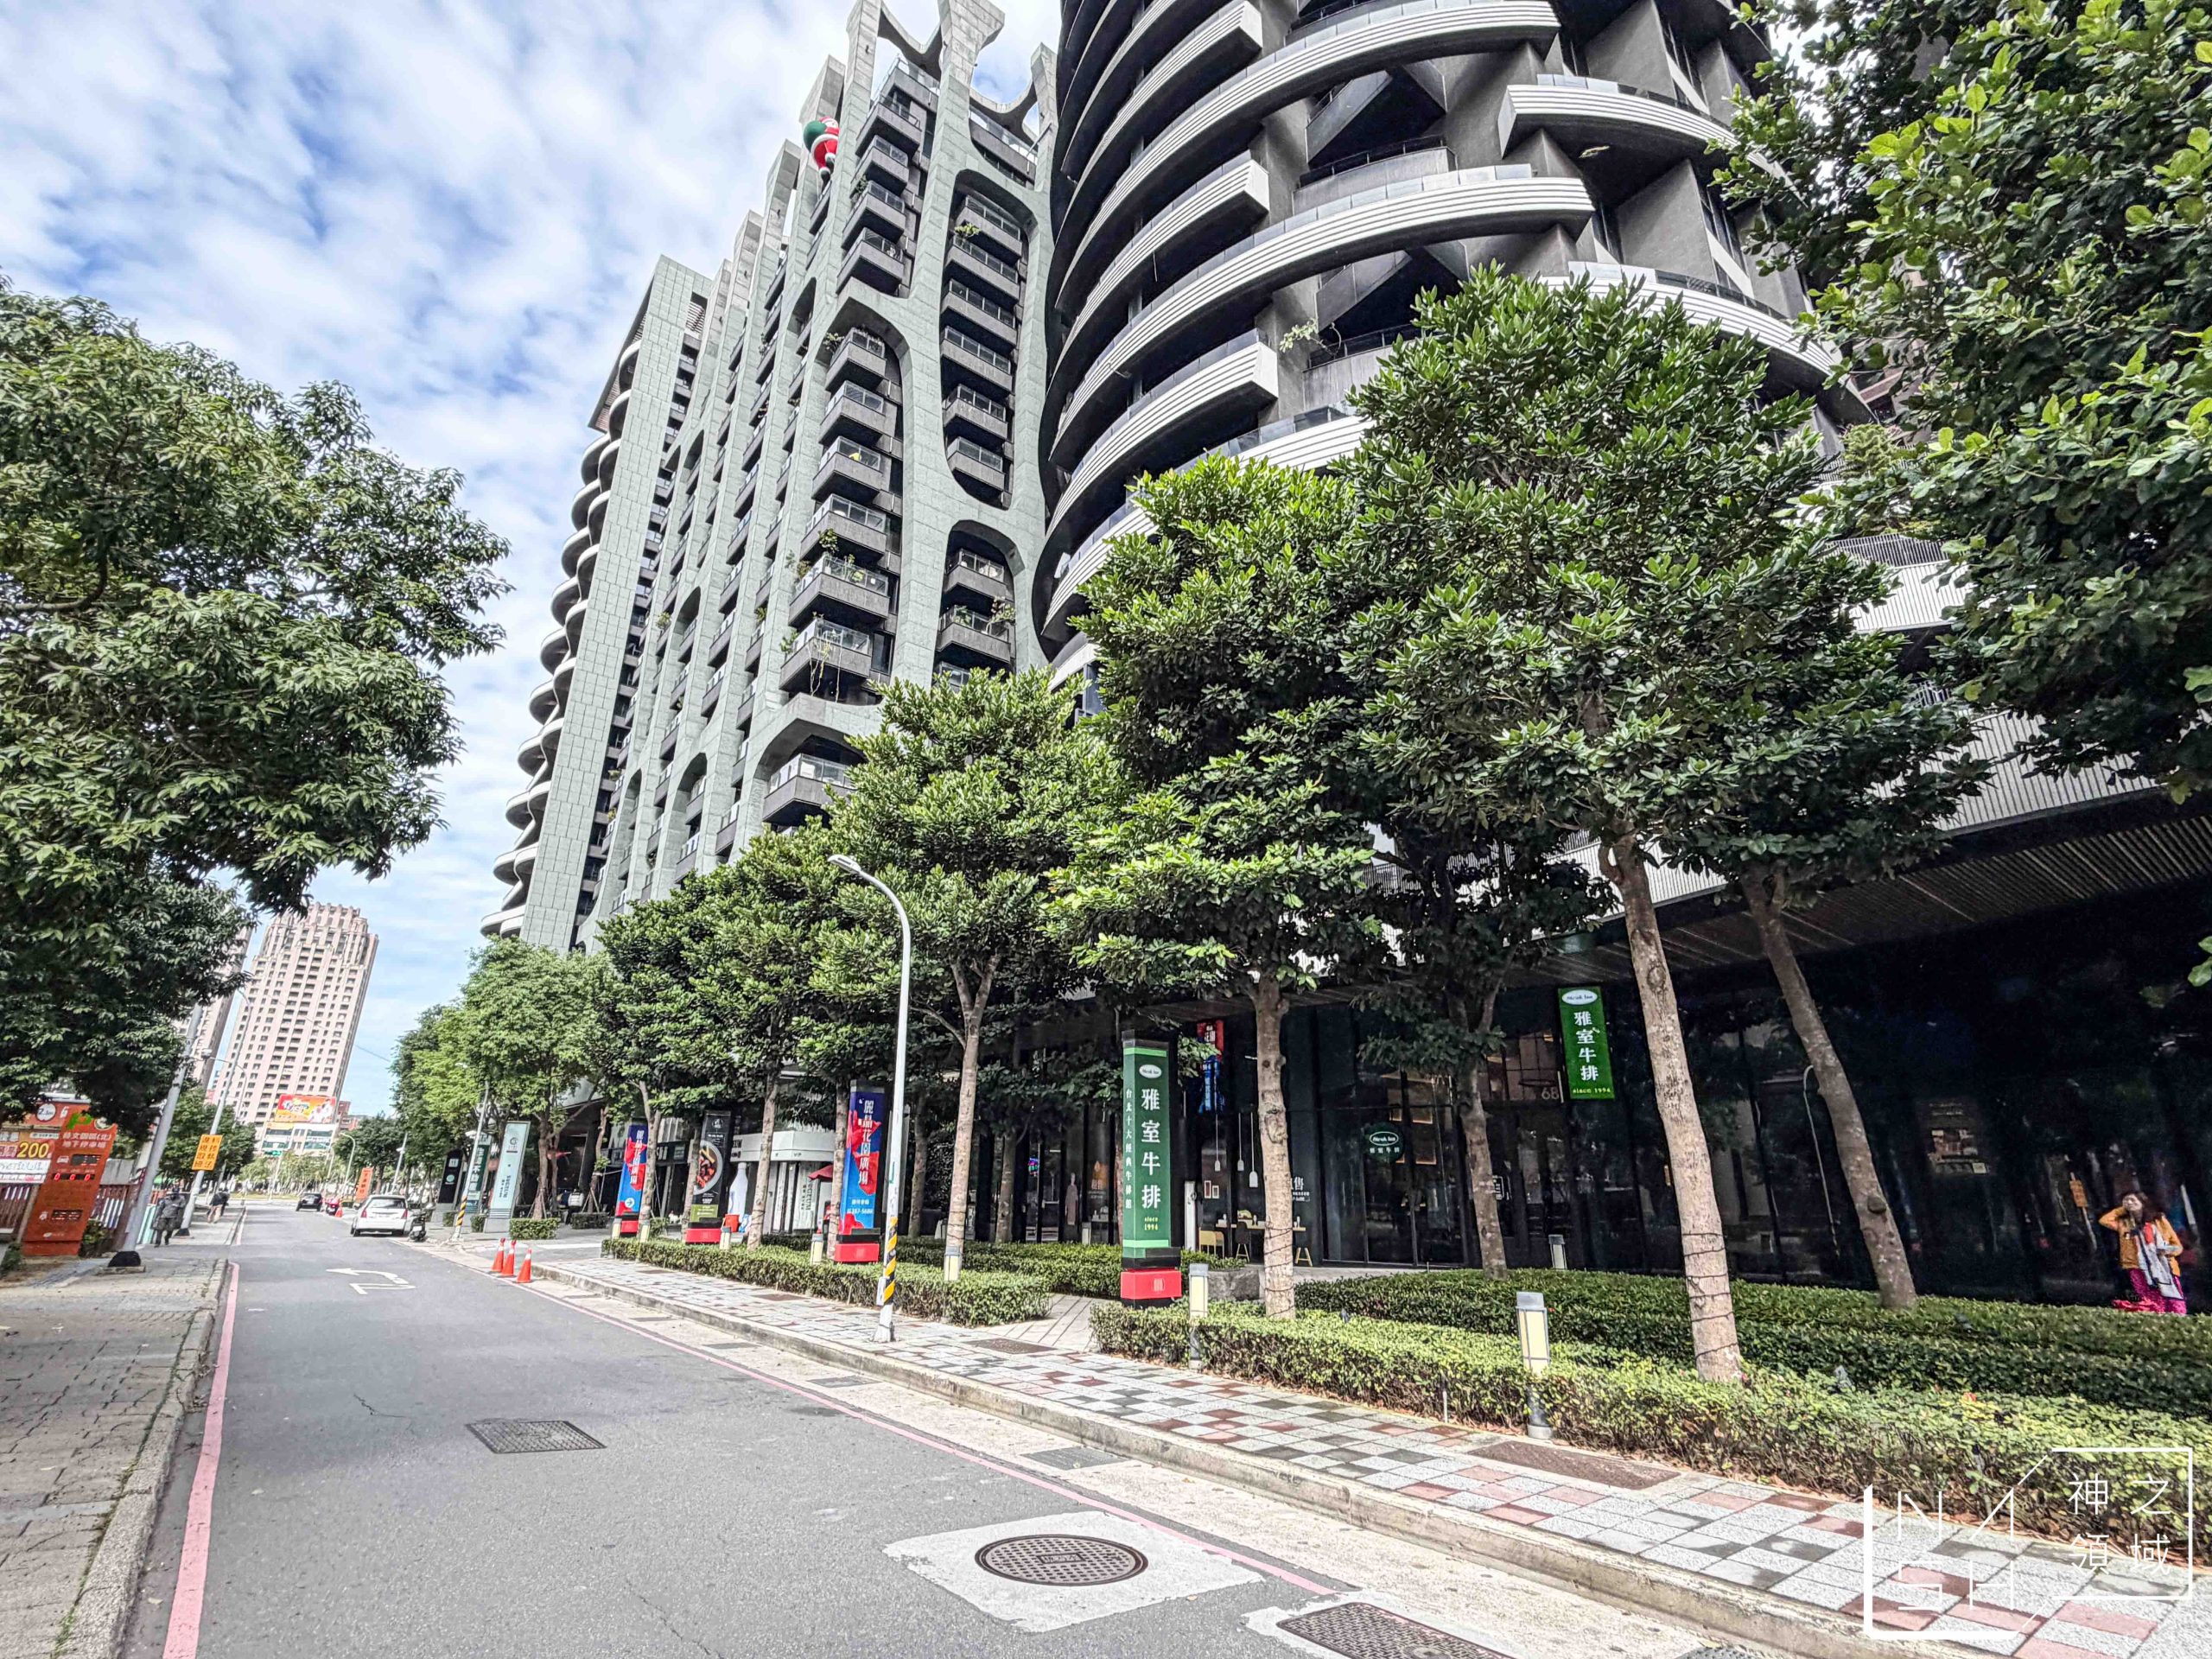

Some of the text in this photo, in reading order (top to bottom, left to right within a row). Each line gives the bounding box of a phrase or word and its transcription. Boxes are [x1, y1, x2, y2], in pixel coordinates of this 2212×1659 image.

[1573, 1011, 1600, 1081] 雅室牛排
[16, 1141, 49, 1158] 200
[1141, 1088, 1161, 1209] 雅室牛排
